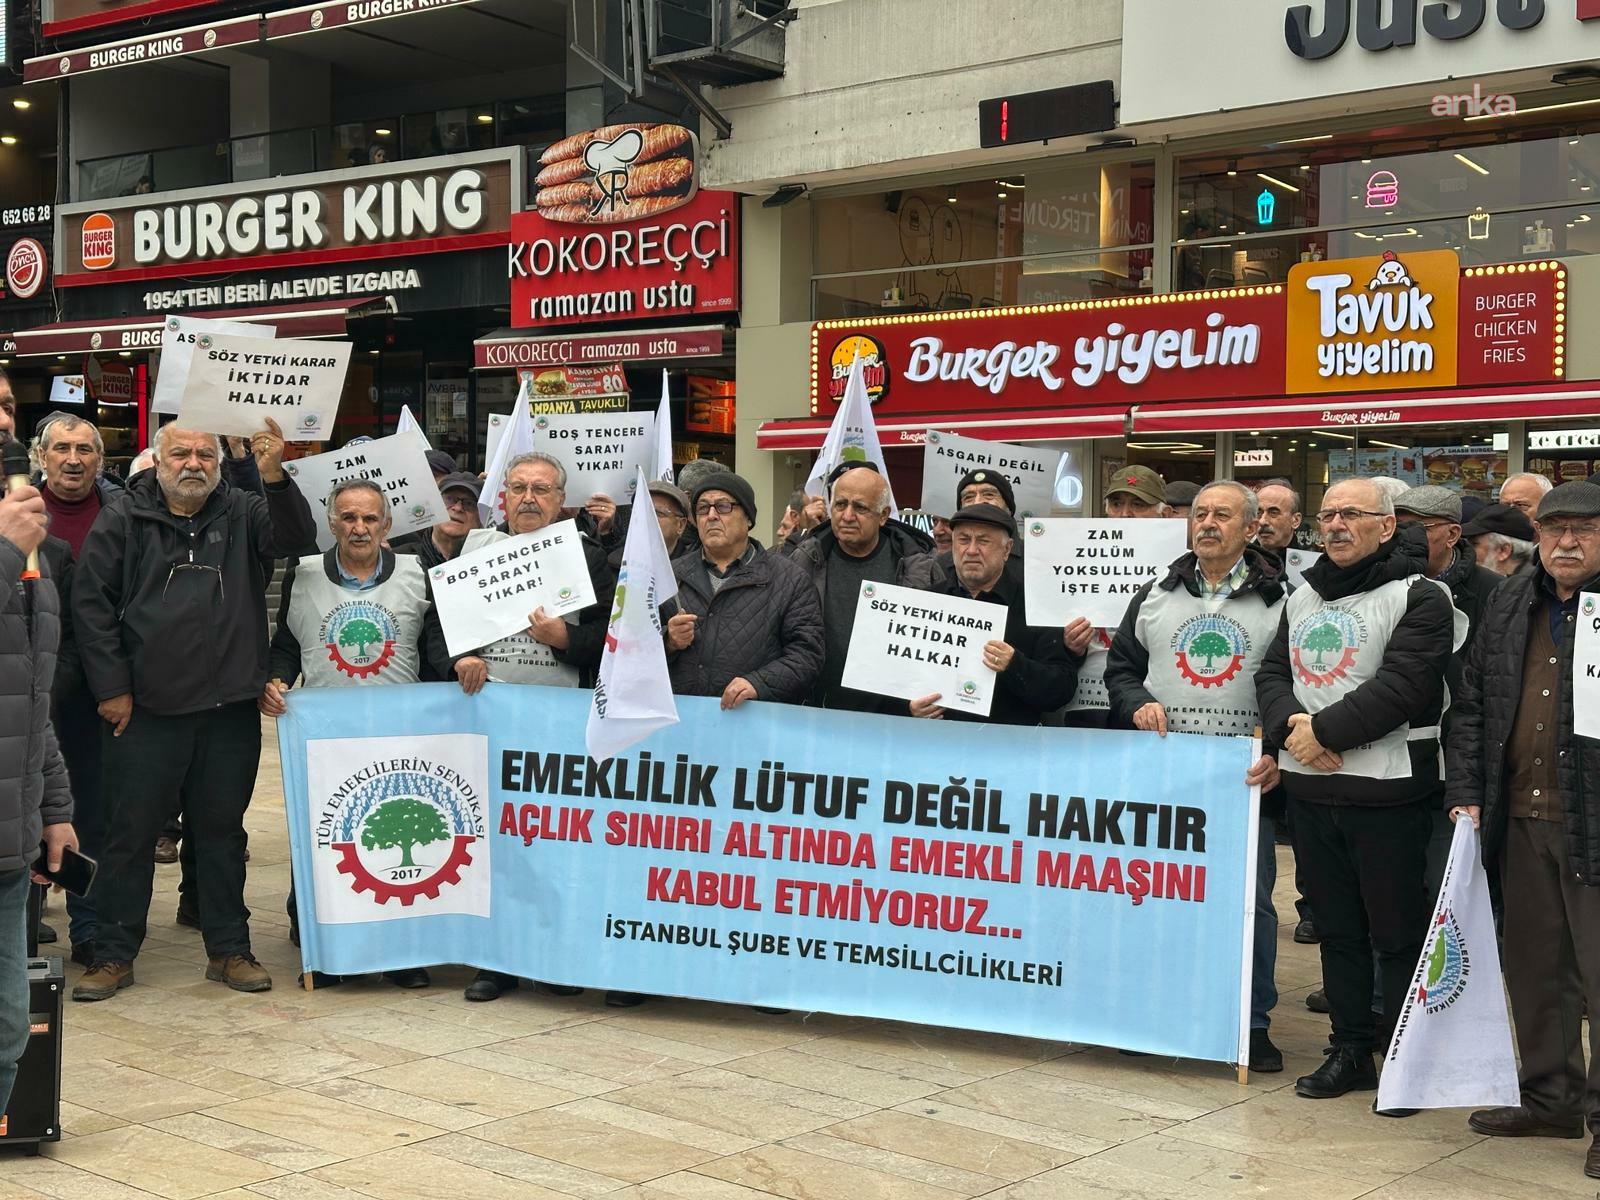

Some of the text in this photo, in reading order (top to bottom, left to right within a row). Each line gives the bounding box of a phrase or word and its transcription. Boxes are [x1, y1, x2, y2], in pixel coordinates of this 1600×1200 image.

[90, 37, 184, 68] BURGER KING
[3, 204, 51, 225] 652 66 28
[134, 169, 483, 262] BURGER KING
[84, 230, 114, 258] BURGER KING
[508, 208, 727, 279] KOKOREÇÇİ
[143, 269, 422, 311] 1954'TEN BERİ ALEVDE IZGARA
[530, 288, 632, 320] ramazan
[643, 279, 693, 310] usta
[1475, 292, 1537, 311] BURGER
[1305, 273, 1435, 338] Tavuk
[121, 330, 163, 347] BURG
[1474, 319, 1537, 338] CHICKEN
[208, 349, 337, 368] SÖZ YETKİ KARAR
[581, 341, 640, 358] ramazan
[649, 338, 677, 355] usta
[903, 311, 1262, 394] Burger yiyelim
[1317, 338, 1434, 378] yiyelim
[1483, 347, 1527, 364] FRIES
[228, 367, 311, 386] İKTİDAR
[602, 374, 624, 393] 80
[228, 391, 303, 406] HALKA!
[529, 398, 626, 416] AMPANYA TAVUKLU
[1321, 410, 1401, 424] Burger yiyelim
[549, 426, 645, 441] BOŞ TENCERE
[334, 454, 367, 471] ZAM
[575, 444, 625, 456] SARAYI
[936, 446, 1045, 473] ASGARİ DEĞİL
[576, 460, 623, 471] YIKAR!
[1088, 529, 1123, 540] ZAM
[446, 535, 564, 585] BOŞ TENCERE
[1076, 545, 1135, 558] ZULÜM
[478, 560, 540, 589] SARAYI
[1052, 565, 1158, 576] YOKSULLUK
[483, 576, 543, 603] YIKAR!
[1061, 580, 1100, 596] İŞTE
[319, 599, 402, 642] TÜM EMEKLİLERİN SENDİKASI
[870, 598, 993, 632] SÖZ YETKİ KARAR
[888, 619, 968, 648] İKTİDAR
[1170, 612, 1252, 651] TÜM EMEKLİLERİN SENDİKASI
[887, 643, 960, 668] HALKA!
[316, 756, 485, 848] TÜM EMEKLİLERİN SENDİKASI
[500, 749, 1208, 853] EMEKLİLİK LÜTUF DEĞİL HAKTIR
[499, 801, 1207, 906] AÇLIK SINIRI ALTINDA EMEKLİ MAAŞINI
[391, 868, 422, 881] 2017
[646, 866, 1023, 940] KABUL ETMİYORUZ...
[604, 913, 1065, 988] İSTANBUL ŞUBE VE TEMSİLLCİLİKLERİ
